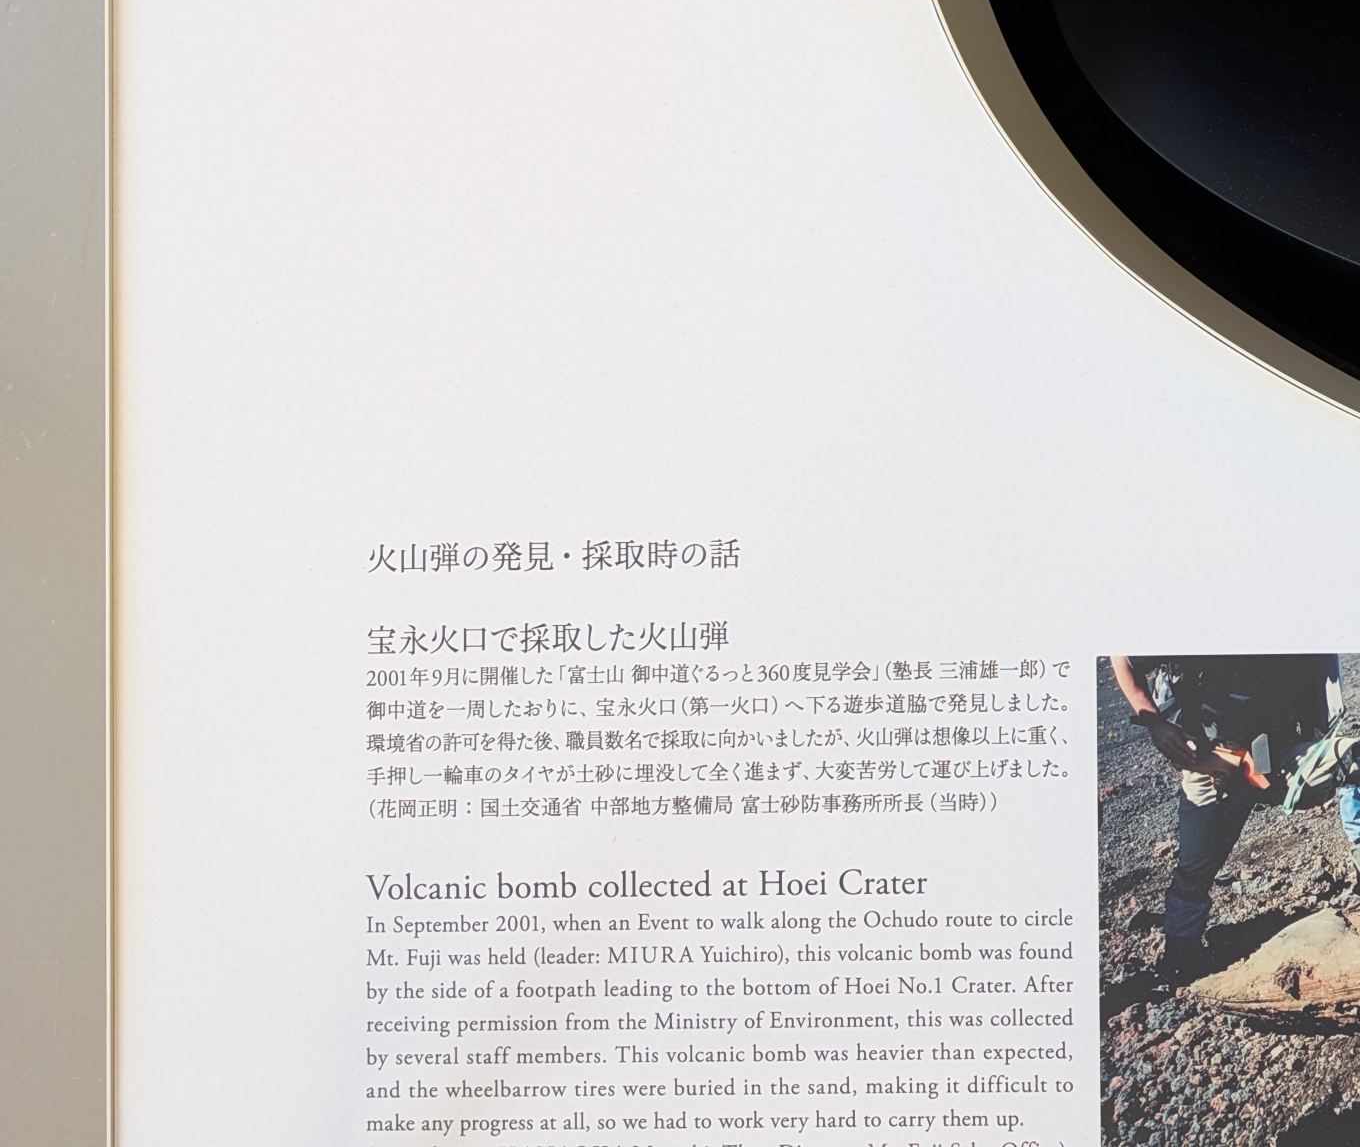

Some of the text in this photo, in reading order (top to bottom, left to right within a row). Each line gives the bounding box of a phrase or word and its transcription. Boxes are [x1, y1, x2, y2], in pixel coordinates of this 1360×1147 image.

[368, 539, 740, 573] 火山弾の発見・採取時の話
[368, 621, 729, 655] 宝永火口で採取した火山弾
[592, 795, 733, 816] 中部地方整備局
[366, 869, 927, 900] Volcanic bomb collected at Hoei Crater
[367, 908, 1073, 938] In September 2001, when an Event to walk along the Ochudo route to circle
[367, 1008, 1074, 1037] receiving permission from the Ministry of Environment, this was collected
